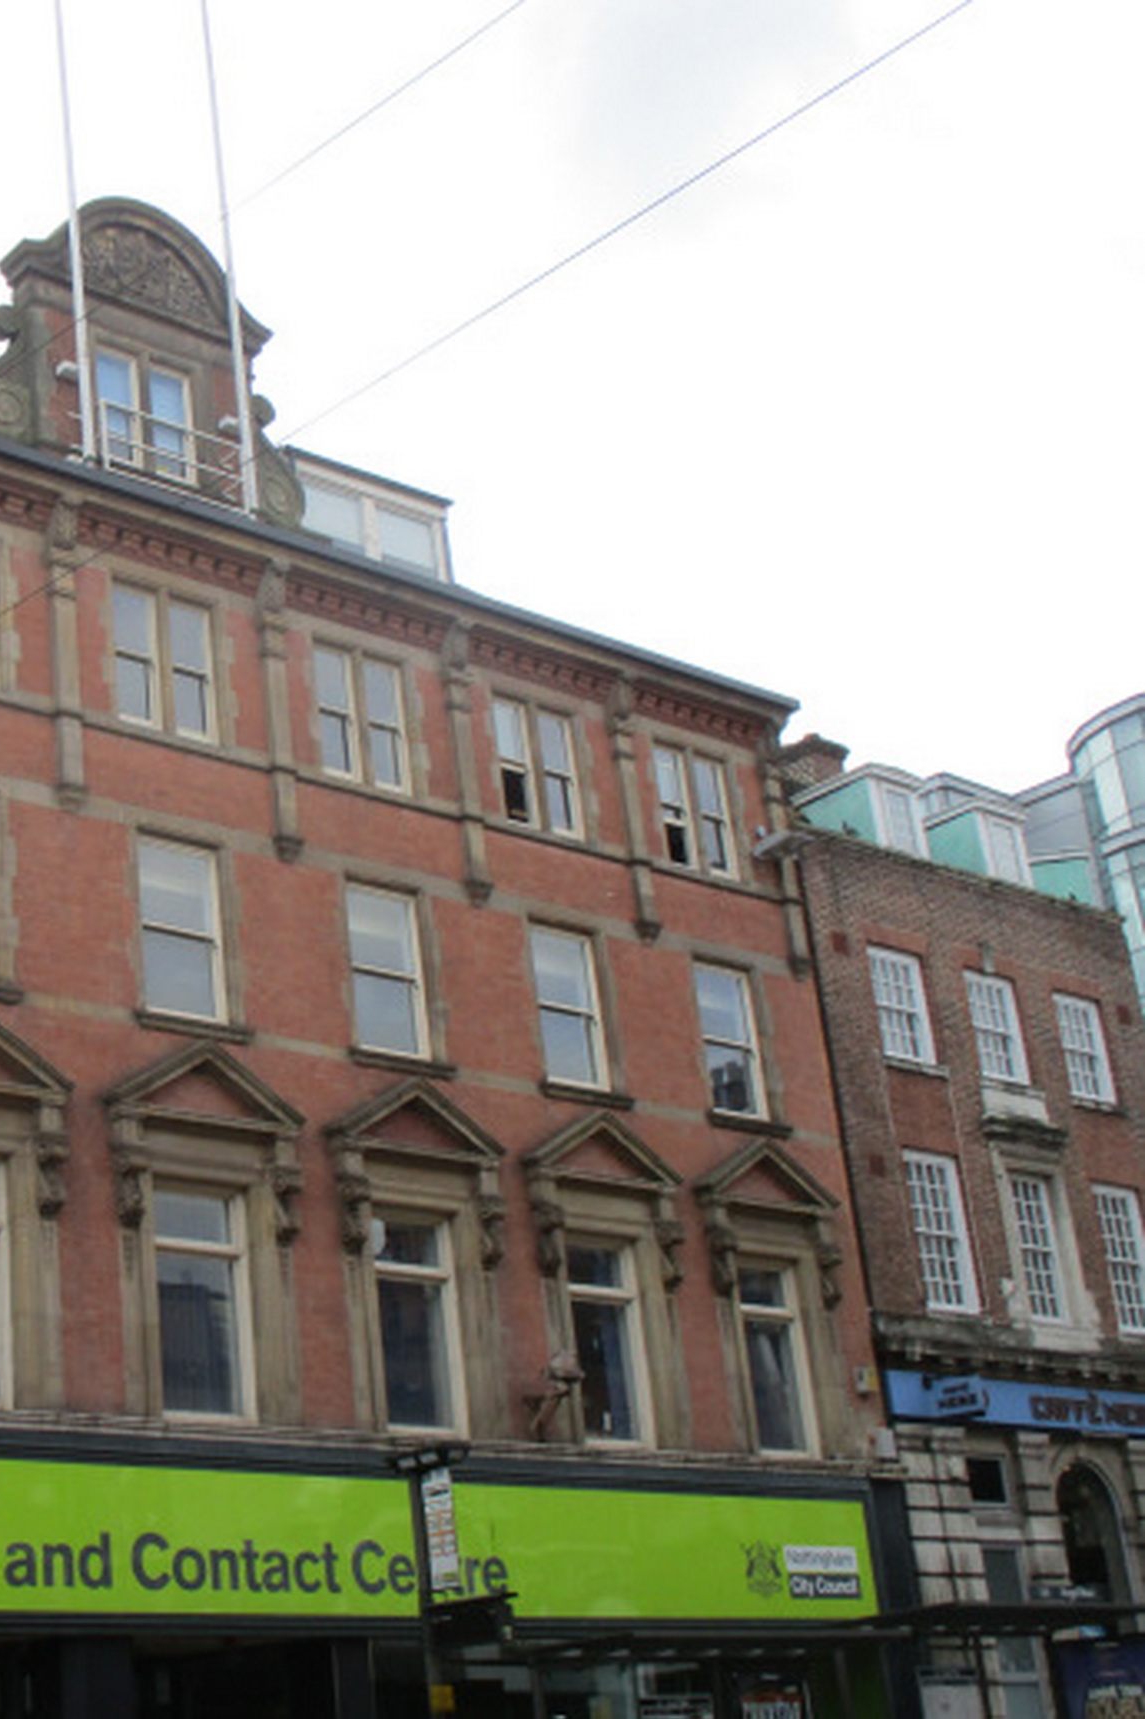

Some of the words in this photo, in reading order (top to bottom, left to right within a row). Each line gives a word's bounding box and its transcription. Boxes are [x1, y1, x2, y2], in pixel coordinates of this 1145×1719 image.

[4, 1532, 113, 1588] and
[131, 1532, 341, 1593] Contact
[351, 1540, 509, 1596] Cere
[791, 1576, 814, 1597] City
[817, 1577, 859, 1595] Council
